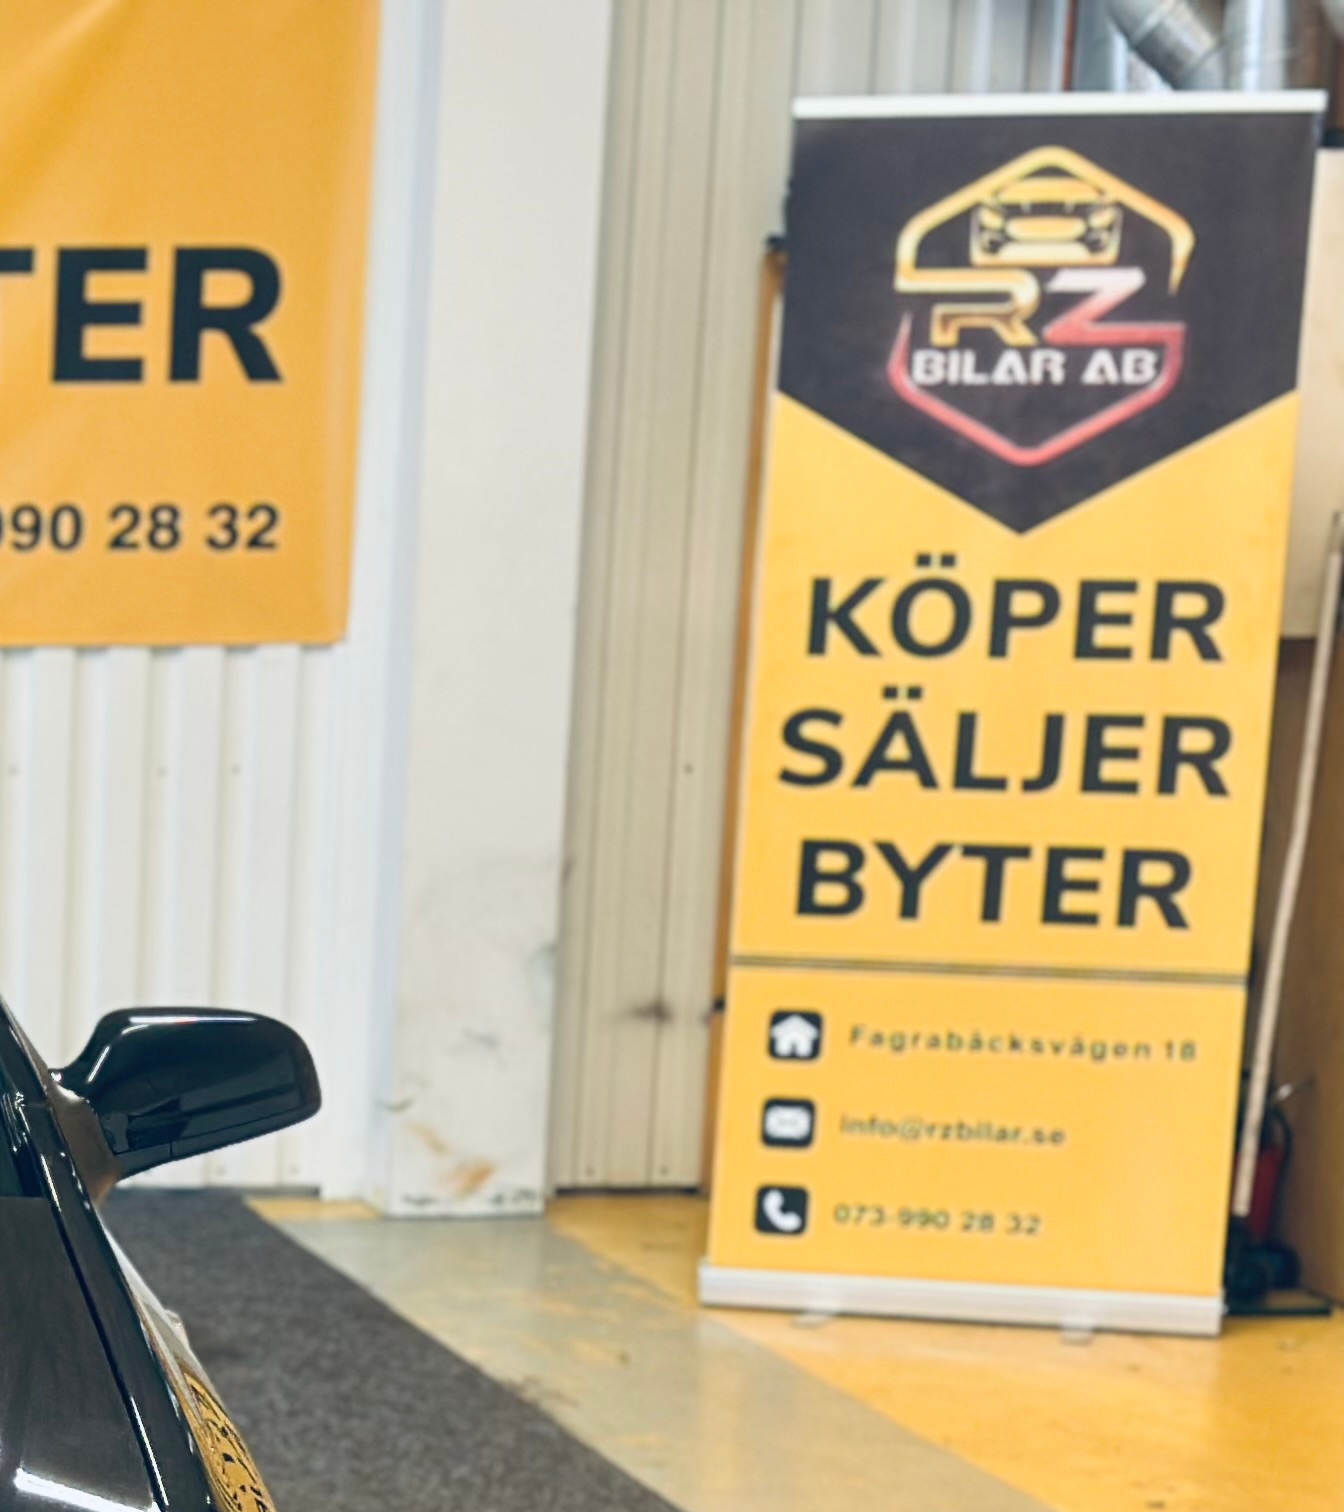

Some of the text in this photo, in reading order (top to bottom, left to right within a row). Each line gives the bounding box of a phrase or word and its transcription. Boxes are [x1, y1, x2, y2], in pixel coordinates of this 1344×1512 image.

[911, 348, 1159, 385] BILAR AB
[108, 503, 181, 551] 28
[205, 503, 279, 551] 32
[806, 553, 1227, 662] KÖPER
[777, 685, 1234, 797] SÄLJER
[795, 838, 1192, 931] BYTER
[848, 1024, 1198, 1062] Fagrabäcksvägen 18
[839, 1114, 1066, 1145] info@rzbilar.se
[833, 1202, 1042, 1235] 073-990 28 32
